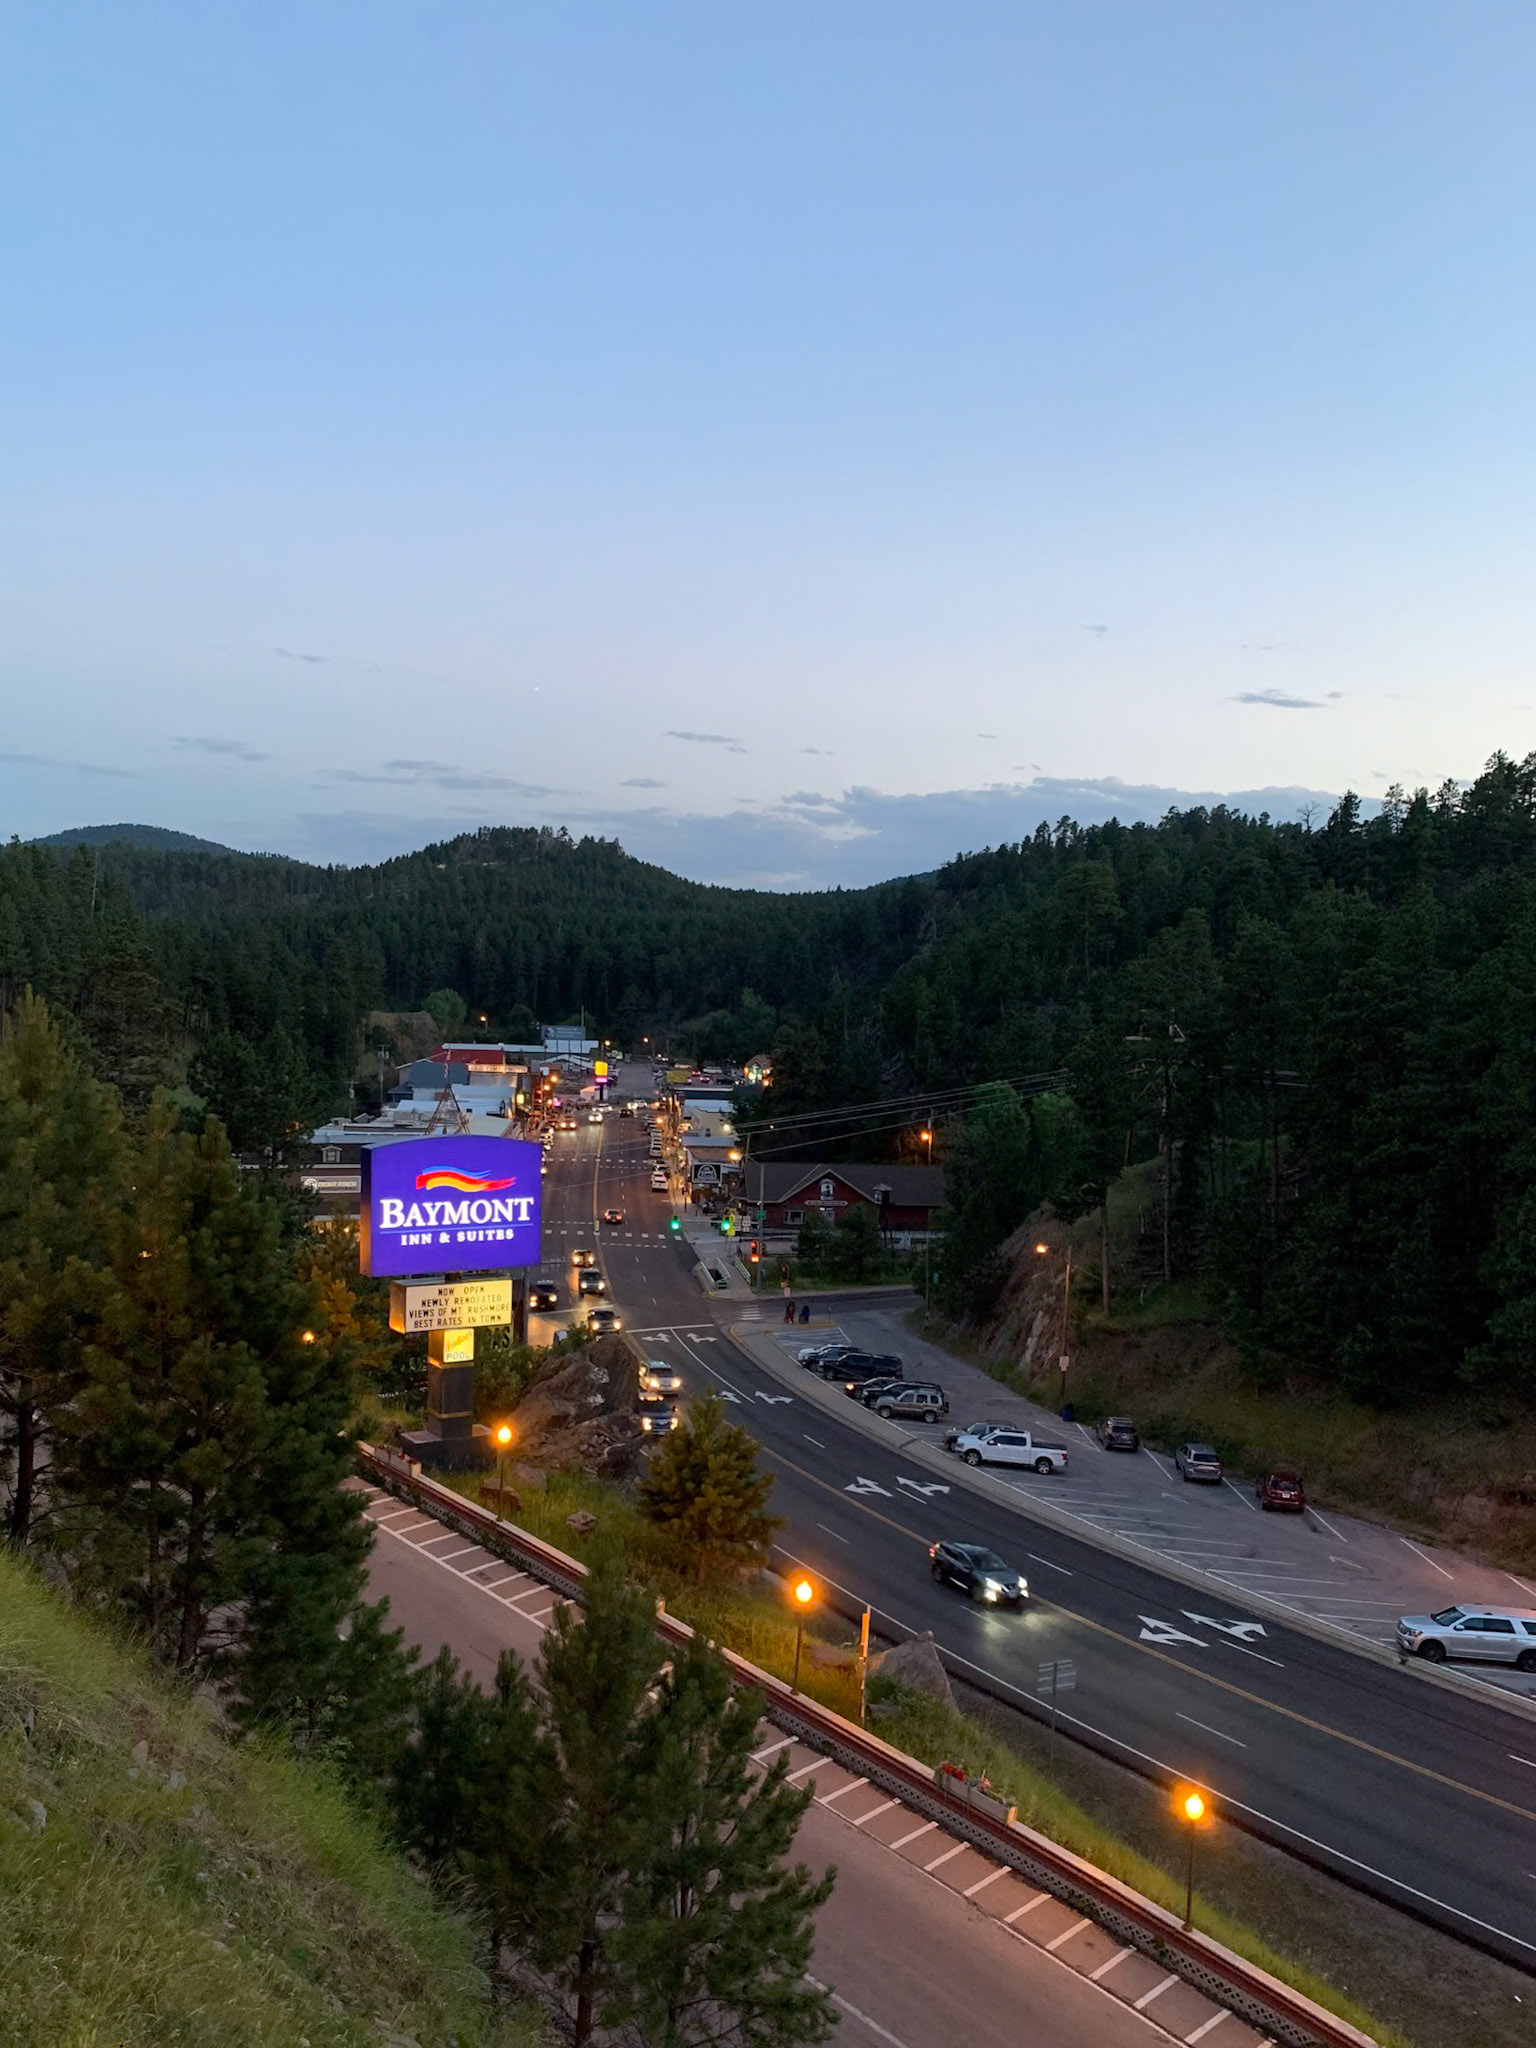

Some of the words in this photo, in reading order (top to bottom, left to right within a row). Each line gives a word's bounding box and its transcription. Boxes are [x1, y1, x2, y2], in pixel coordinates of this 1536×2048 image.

[380, 1197, 534, 1229] BAYMONT
[401, 1233, 432, 1246] INN
[439, 1232, 450, 1244] &
[457, 1229, 515, 1241] SUITES
[438, 1288, 455, 1297] NOW
[463, 1286, 485, 1294] OPEN
[421, 1298, 450, 1307] NEWLY
[454, 1294, 502, 1305] RENOVATED
[409, 1309, 434, 1319] VIEWS
[438, 1307, 447, 1316] OF
[451, 1306, 462, 1315] MT
[467, 1303, 510, 1314] RUSHMORE
[413, 1319, 434, 1328] BEST
[437, 1317, 463, 1326] RATES
[468, 1316, 476, 1324] IN
[480, 1314, 502, 1323] TOWN
[446, 1351, 471, 1361] POOL
